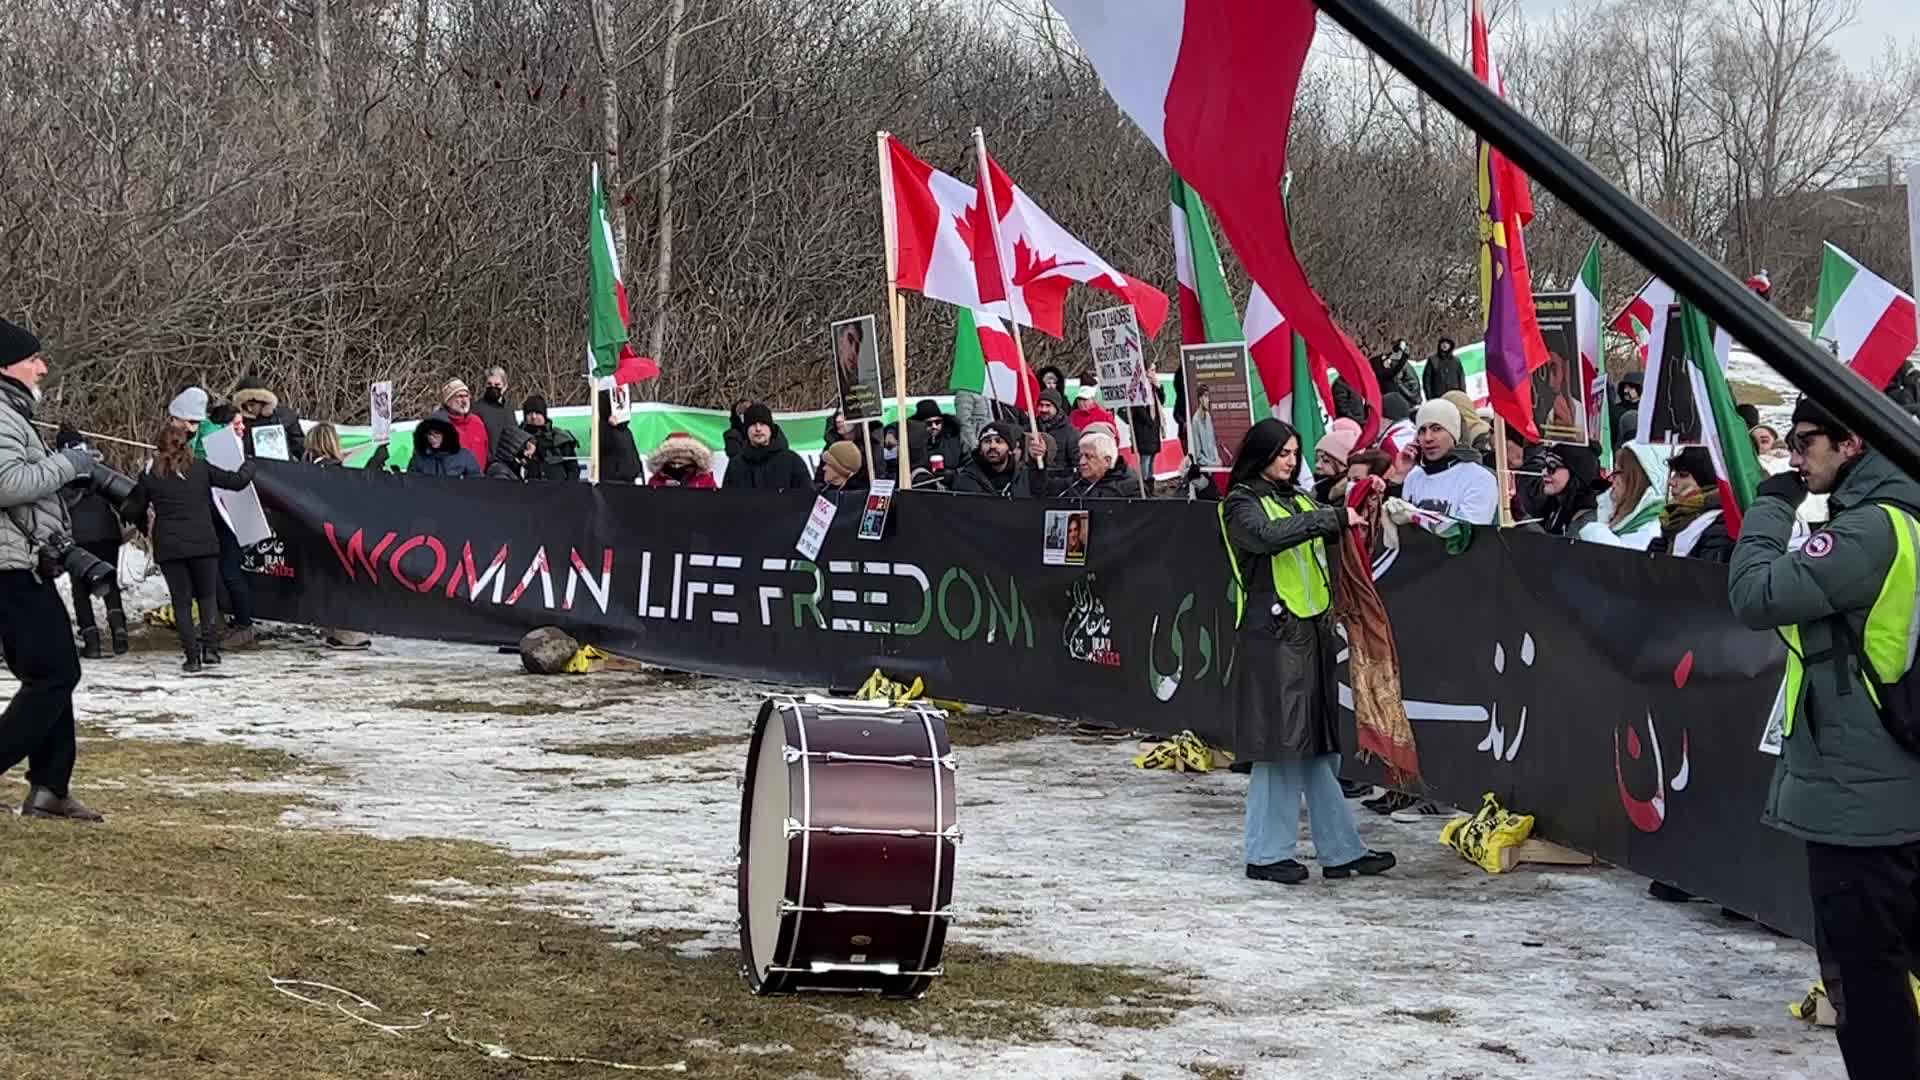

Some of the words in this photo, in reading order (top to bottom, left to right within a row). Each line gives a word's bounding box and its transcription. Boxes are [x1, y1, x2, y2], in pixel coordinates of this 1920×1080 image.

[323, 531, 613, 614] WOMAN
[638, 551, 742, 624] LIFE
[758, 557, 1034, 649] FREEDOM
[1613, 649, 1694, 833] زن
